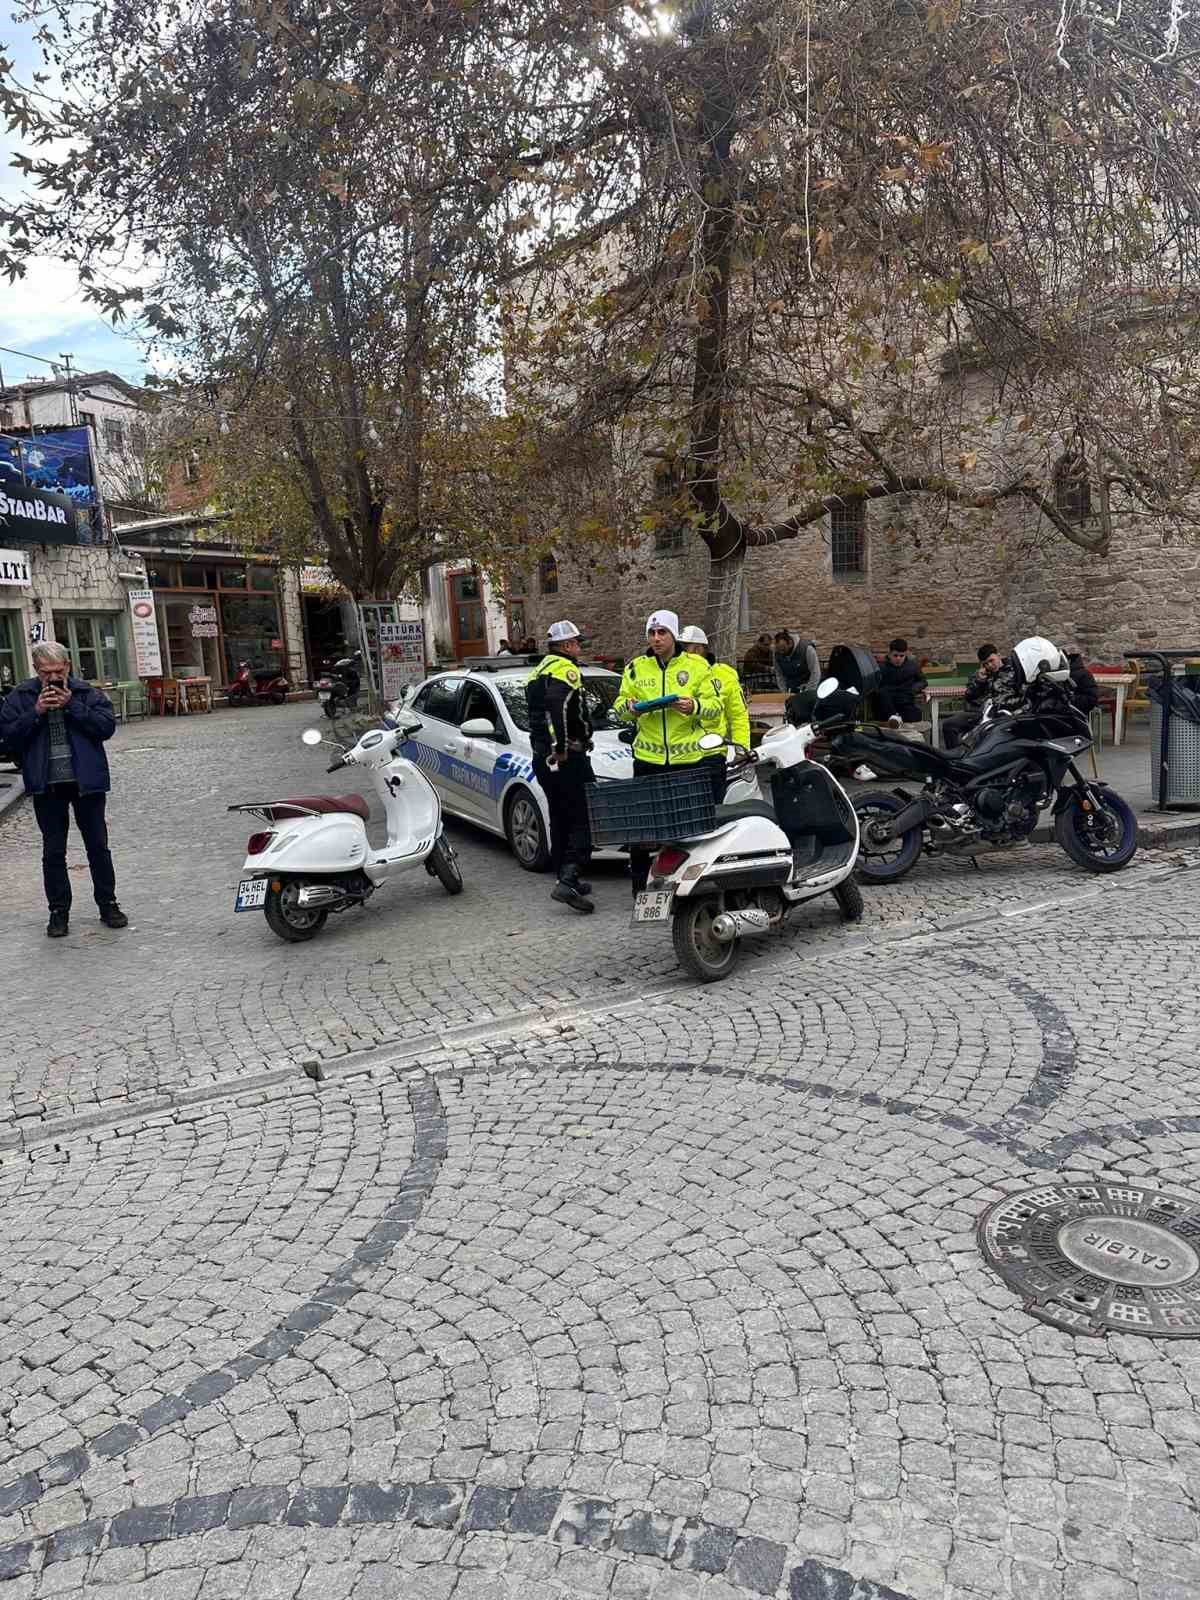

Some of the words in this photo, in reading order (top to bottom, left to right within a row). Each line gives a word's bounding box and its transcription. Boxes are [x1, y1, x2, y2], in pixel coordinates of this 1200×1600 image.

[0, 561, 29, 580] LTI
[380, 623, 421, 635] ERTÜRK
[241, 883, 250, 893] 34
[252, 881, 265, 891] HEL
[245, 894, 259, 904] 731
[637, 894, 648, 905] 35
[656, 893, 671, 904] EY
[643, 906, 661, 918] 886
